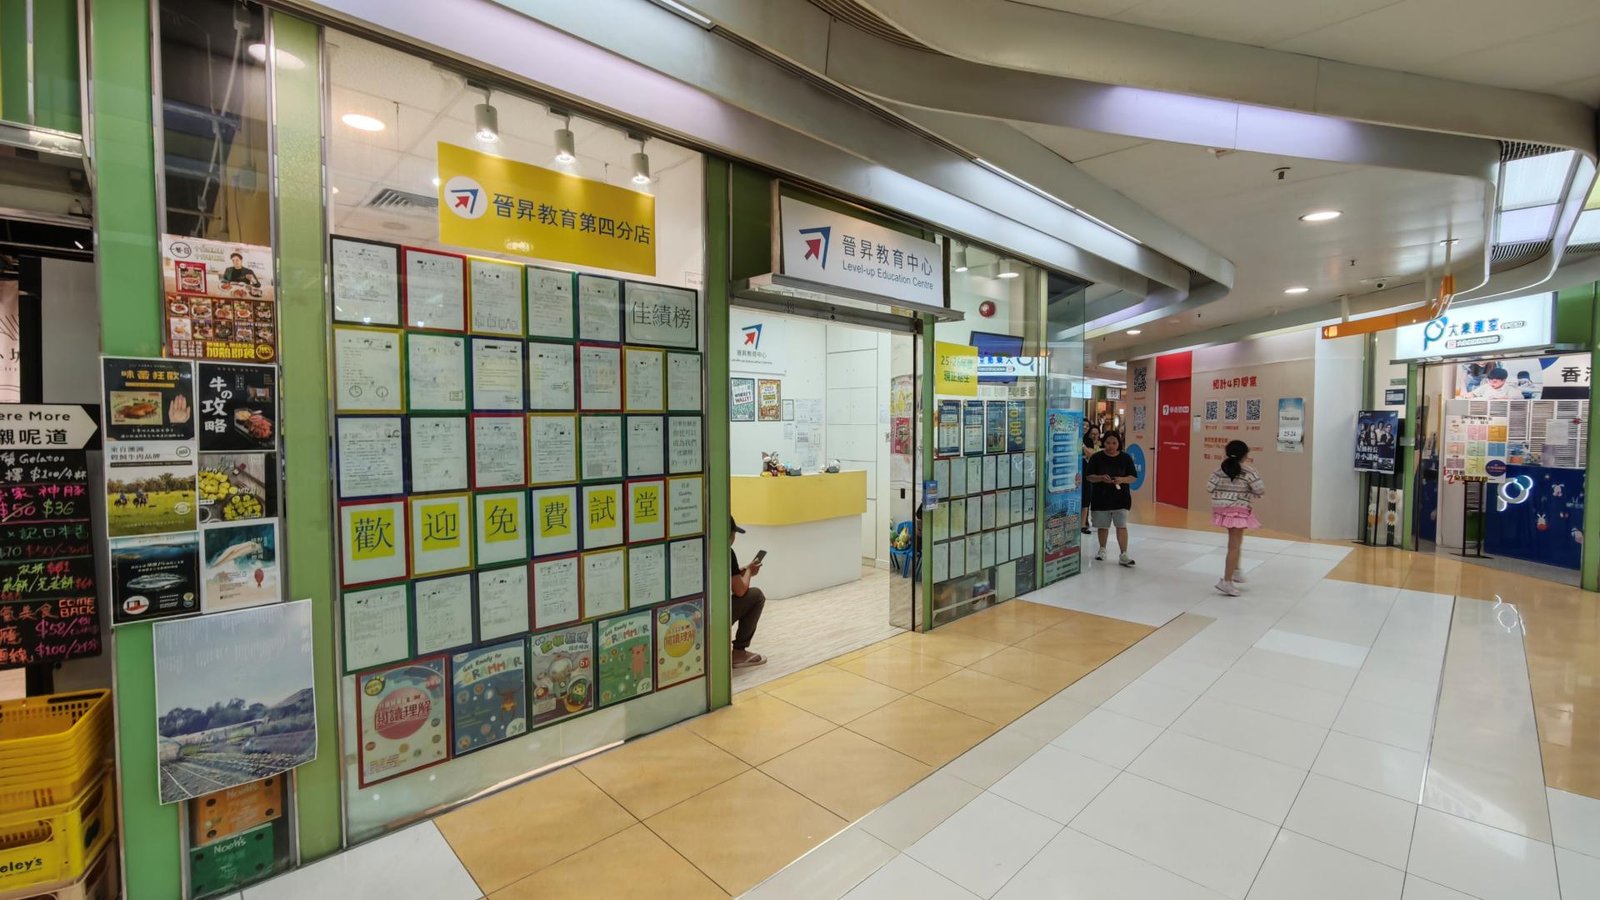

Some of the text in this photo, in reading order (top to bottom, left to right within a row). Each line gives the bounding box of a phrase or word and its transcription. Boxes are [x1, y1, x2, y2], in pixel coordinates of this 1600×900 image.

[492, 193, 651, 245] 晉昇教育第四分店
[842, 234, 933, 277] 晉昇教育中心
[842, 261, 934, 290] Level-up Education Centre
[632, 300, 692, 330] 佳績榜
[29, 411, 71, 421] More
[201, 376, 233, 434] 牛の攻略
[60, 606, 96, 618] BACK
[462, 656, 523, 685] GRAMMAR
[375, 699, 432, 731] 閱讀理解
